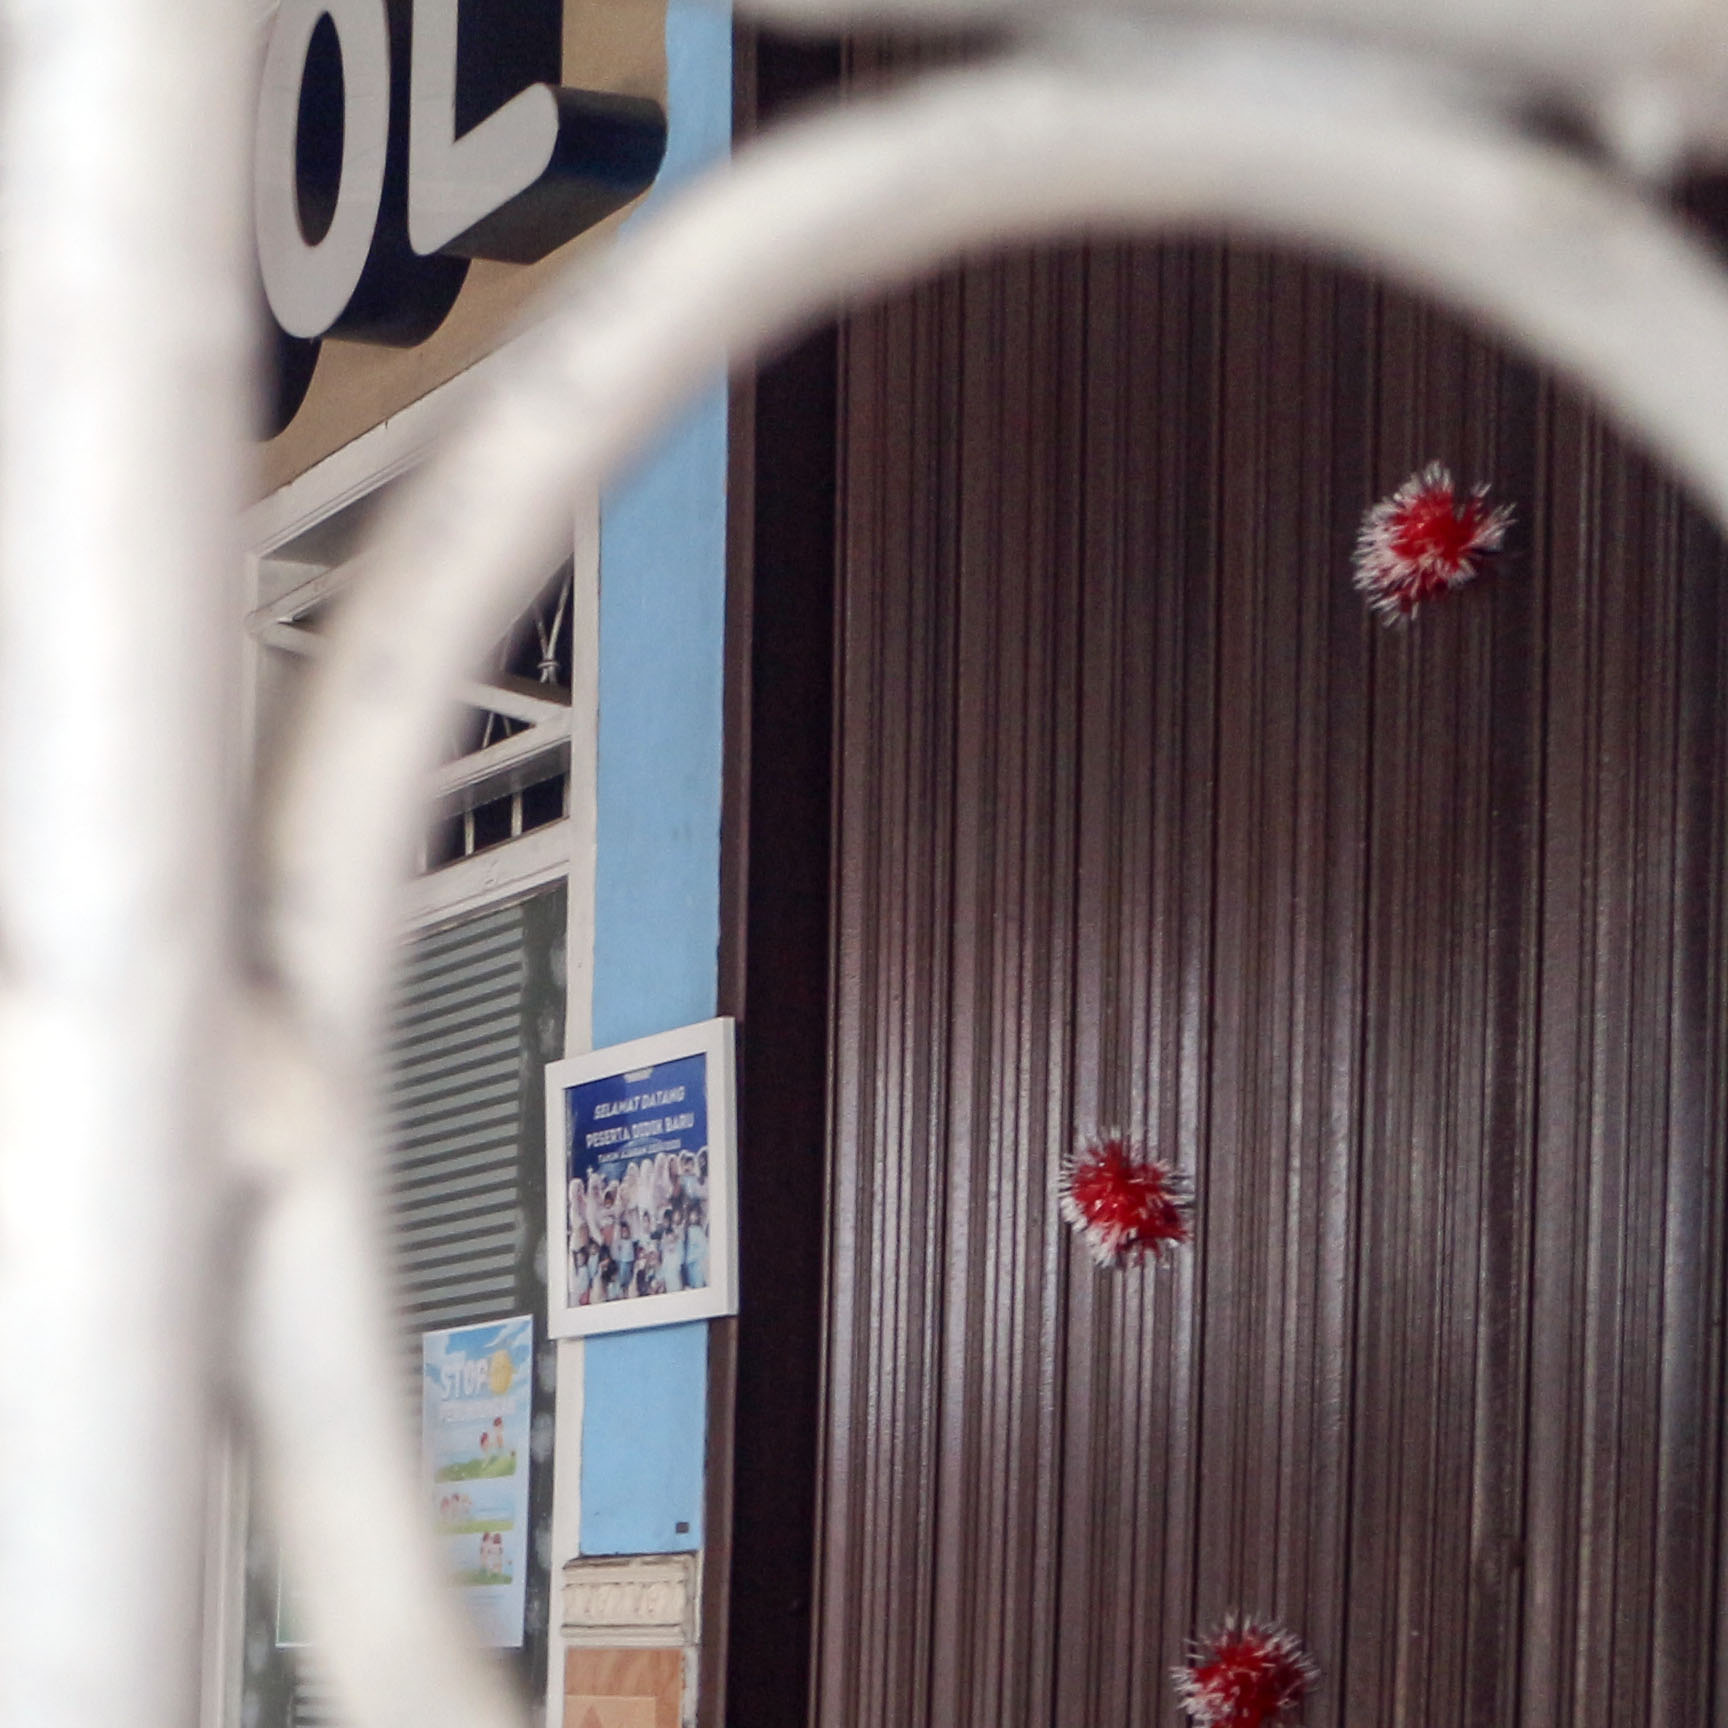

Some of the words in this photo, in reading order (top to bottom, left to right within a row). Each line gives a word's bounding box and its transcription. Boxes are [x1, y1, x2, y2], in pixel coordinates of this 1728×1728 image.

[594, 1096, 640, 1120] SELAMAT
[640, 1085, 685, 1110] DATANG
[586, 1126, 631, 1148] PESERTA
[664, 1112, 695, 1133] BARU
